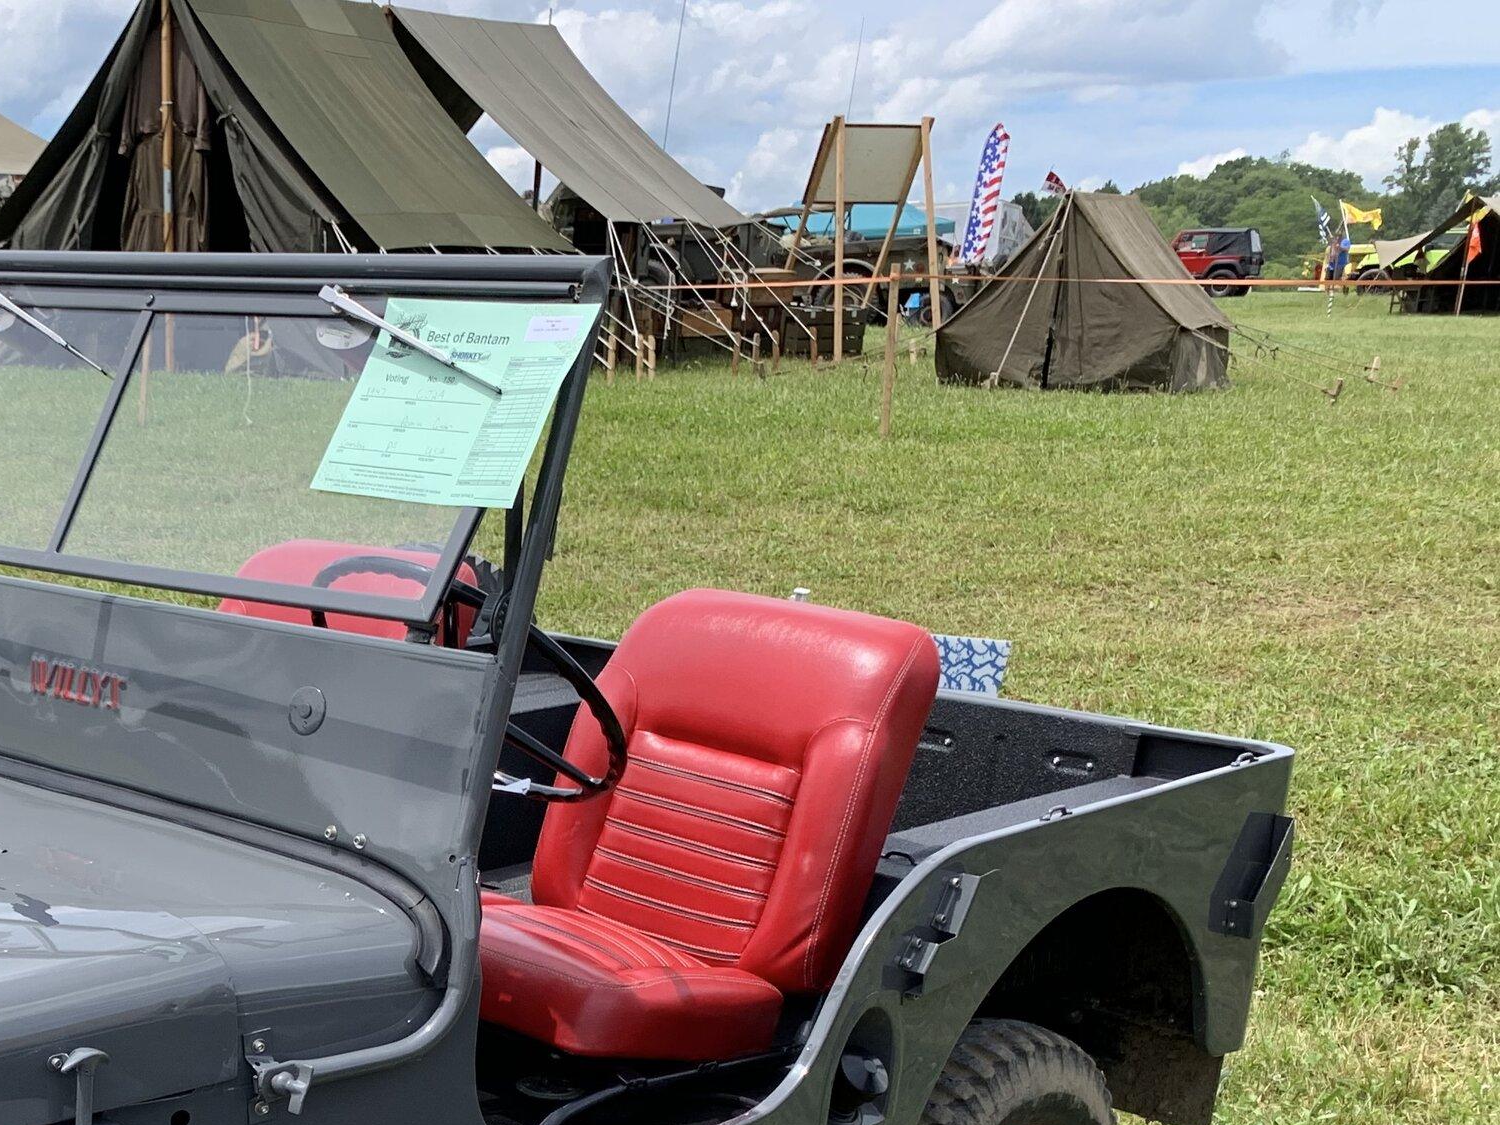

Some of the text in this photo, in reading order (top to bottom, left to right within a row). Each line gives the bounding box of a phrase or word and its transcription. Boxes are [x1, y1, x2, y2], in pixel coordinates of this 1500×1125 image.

[427, 331, 510, 346] Best of Bantam
[385, 373, 410, 386] Voting
[30, 653, 128, 712] WILLYS
